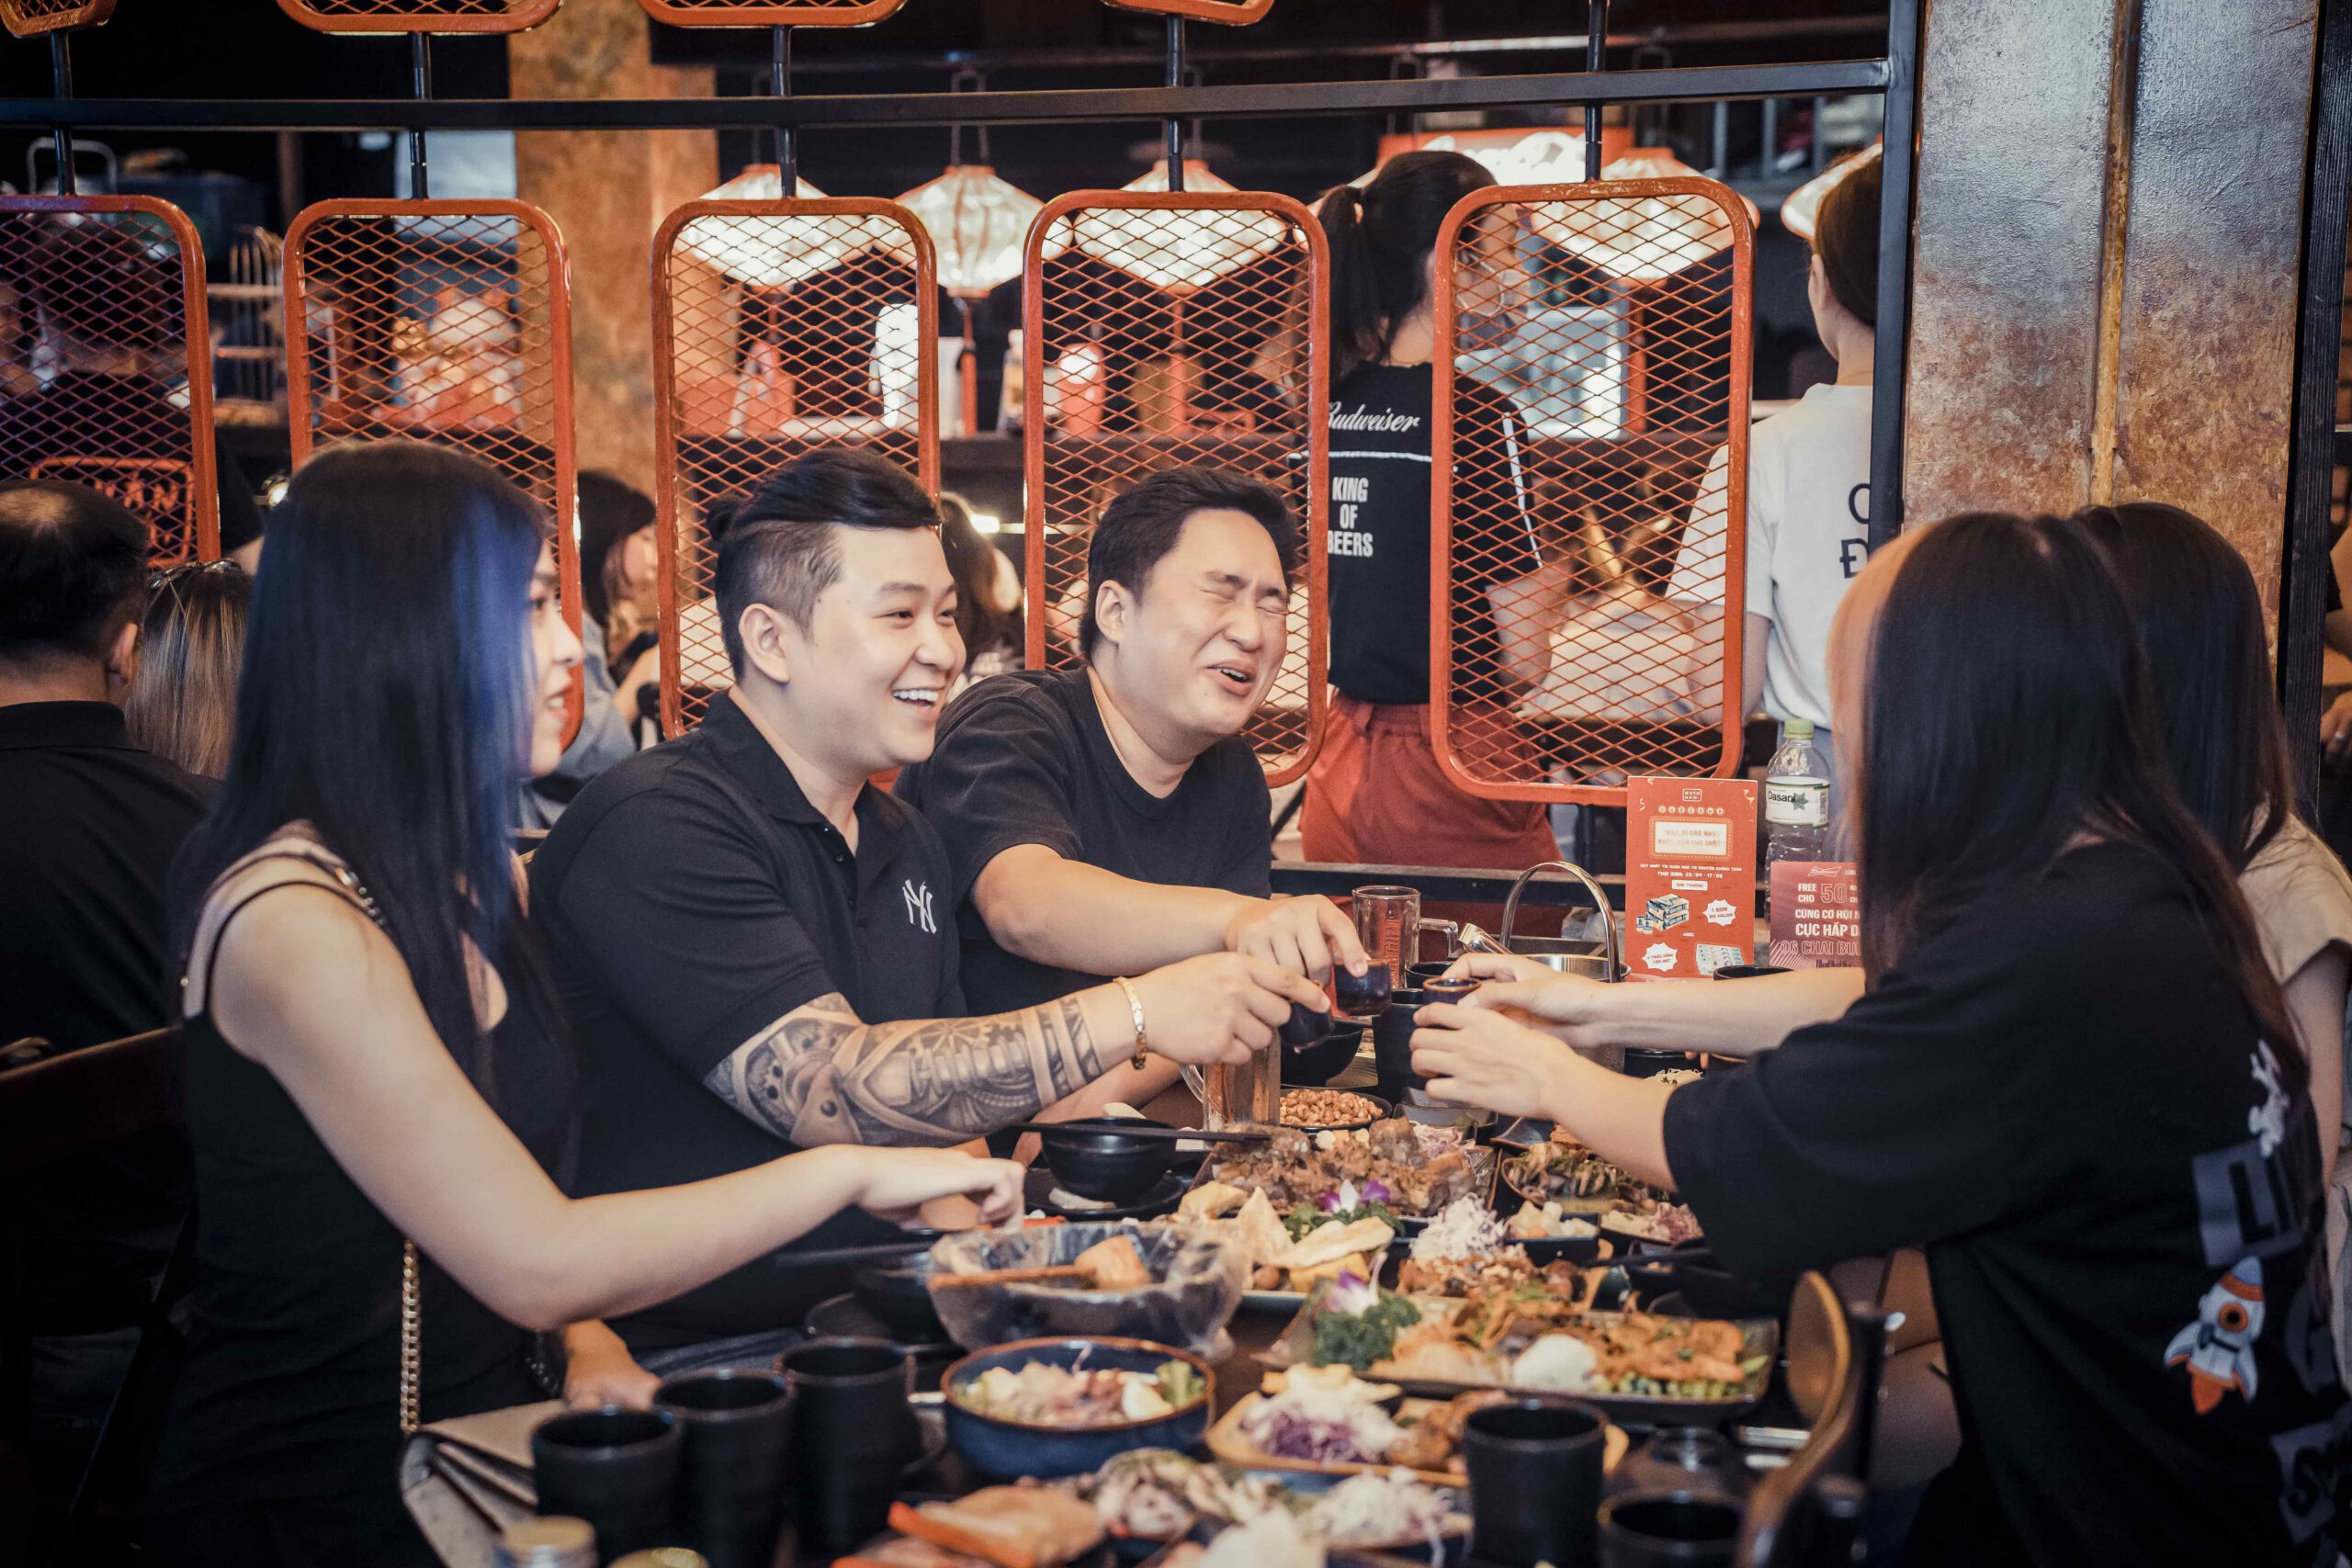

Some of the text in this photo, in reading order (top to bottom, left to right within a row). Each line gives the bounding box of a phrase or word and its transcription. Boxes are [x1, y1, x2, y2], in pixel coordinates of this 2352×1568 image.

[1332, 476, 1369, 502] KING
[1340, 503, 1358, 530] OF
[1768, 790, 1797, 802] Dasani
[1798, 884, 1817, 892] FREE
[1820, 883, 1848, 904] 50
[902, 879, 937, 934] NY
[1798, 894, 1815, 903] CHO
[1795, 908, 1820, 919] CÙNG
[1795, 922, 1820, 938] CỰC
[1823, 921, 1849, 937] HẤP
[1802, 940, 1834, 955] CHAI
